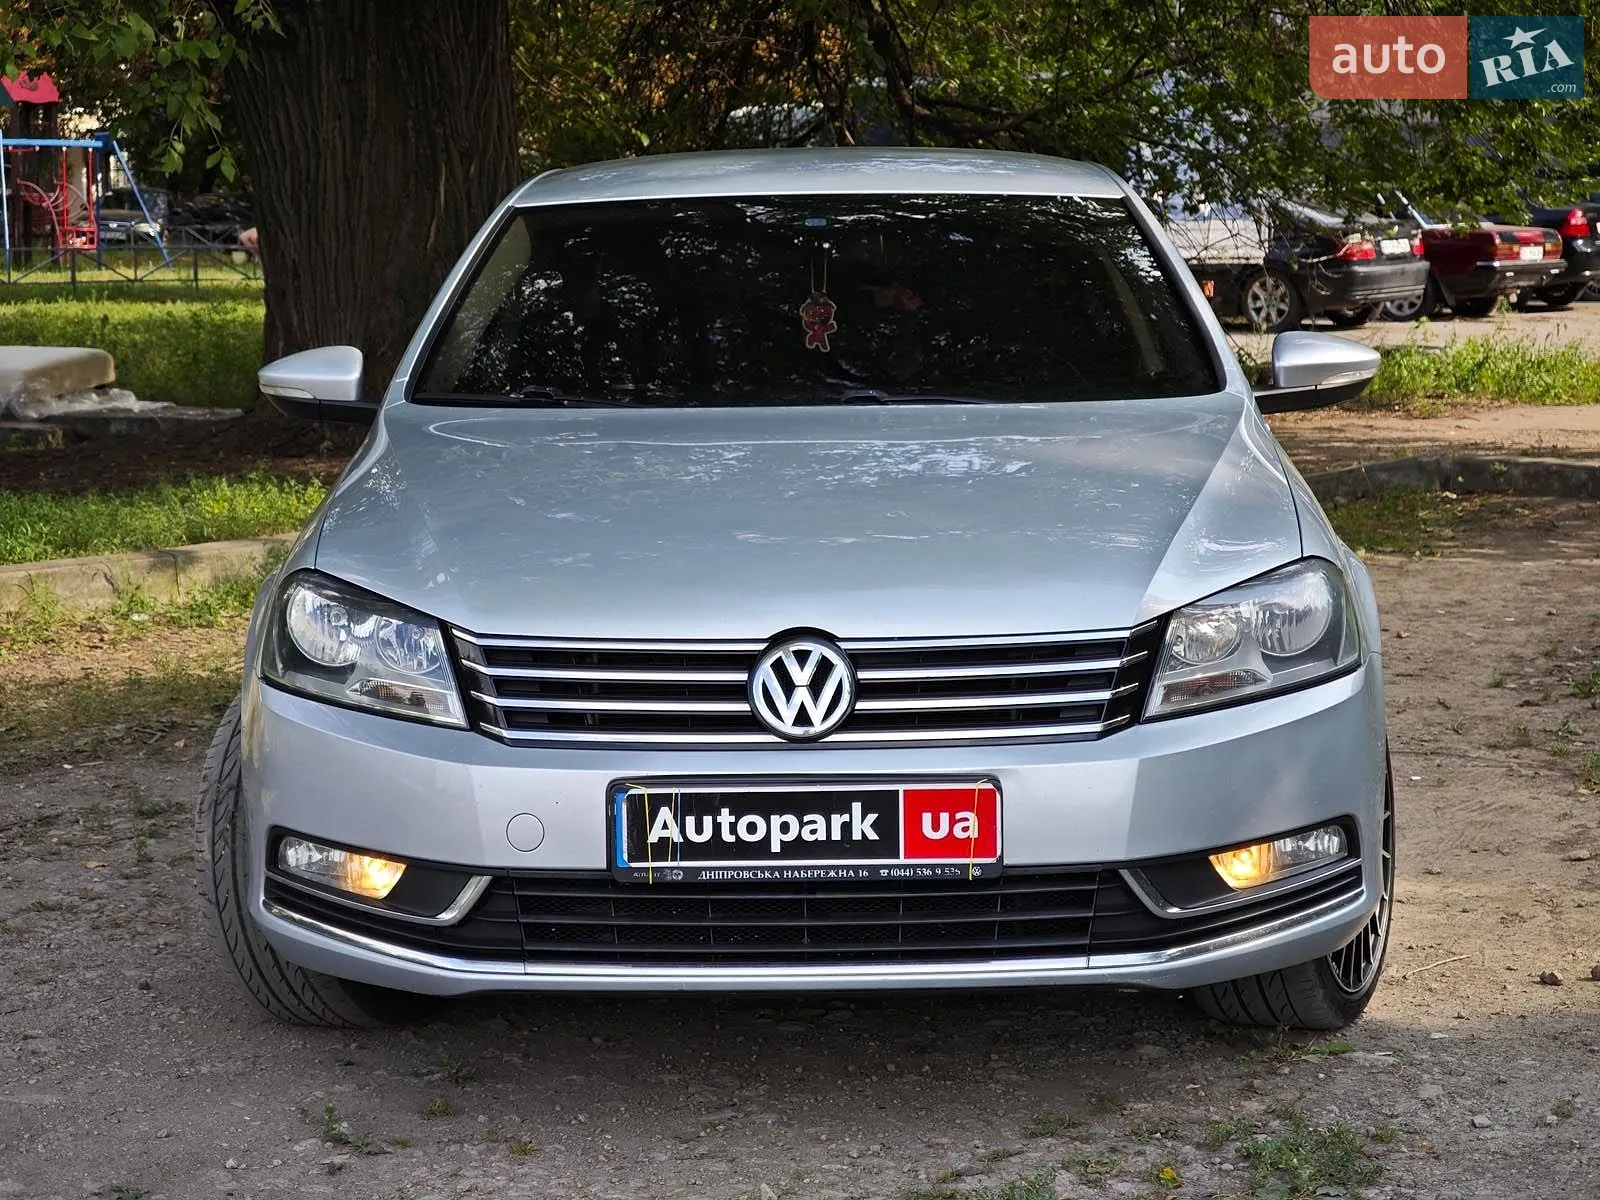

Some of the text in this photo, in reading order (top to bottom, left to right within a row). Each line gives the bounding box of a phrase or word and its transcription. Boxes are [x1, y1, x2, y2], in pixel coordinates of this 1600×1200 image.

[647, 801, 980, 853] Autopark ua
[698, 869, 869, 880] ДНІПРОВСЬКА НАБЕРЕЖНА 16
[890, 867, 914, 877] (044)
[916, 868, 933, 877] 536
